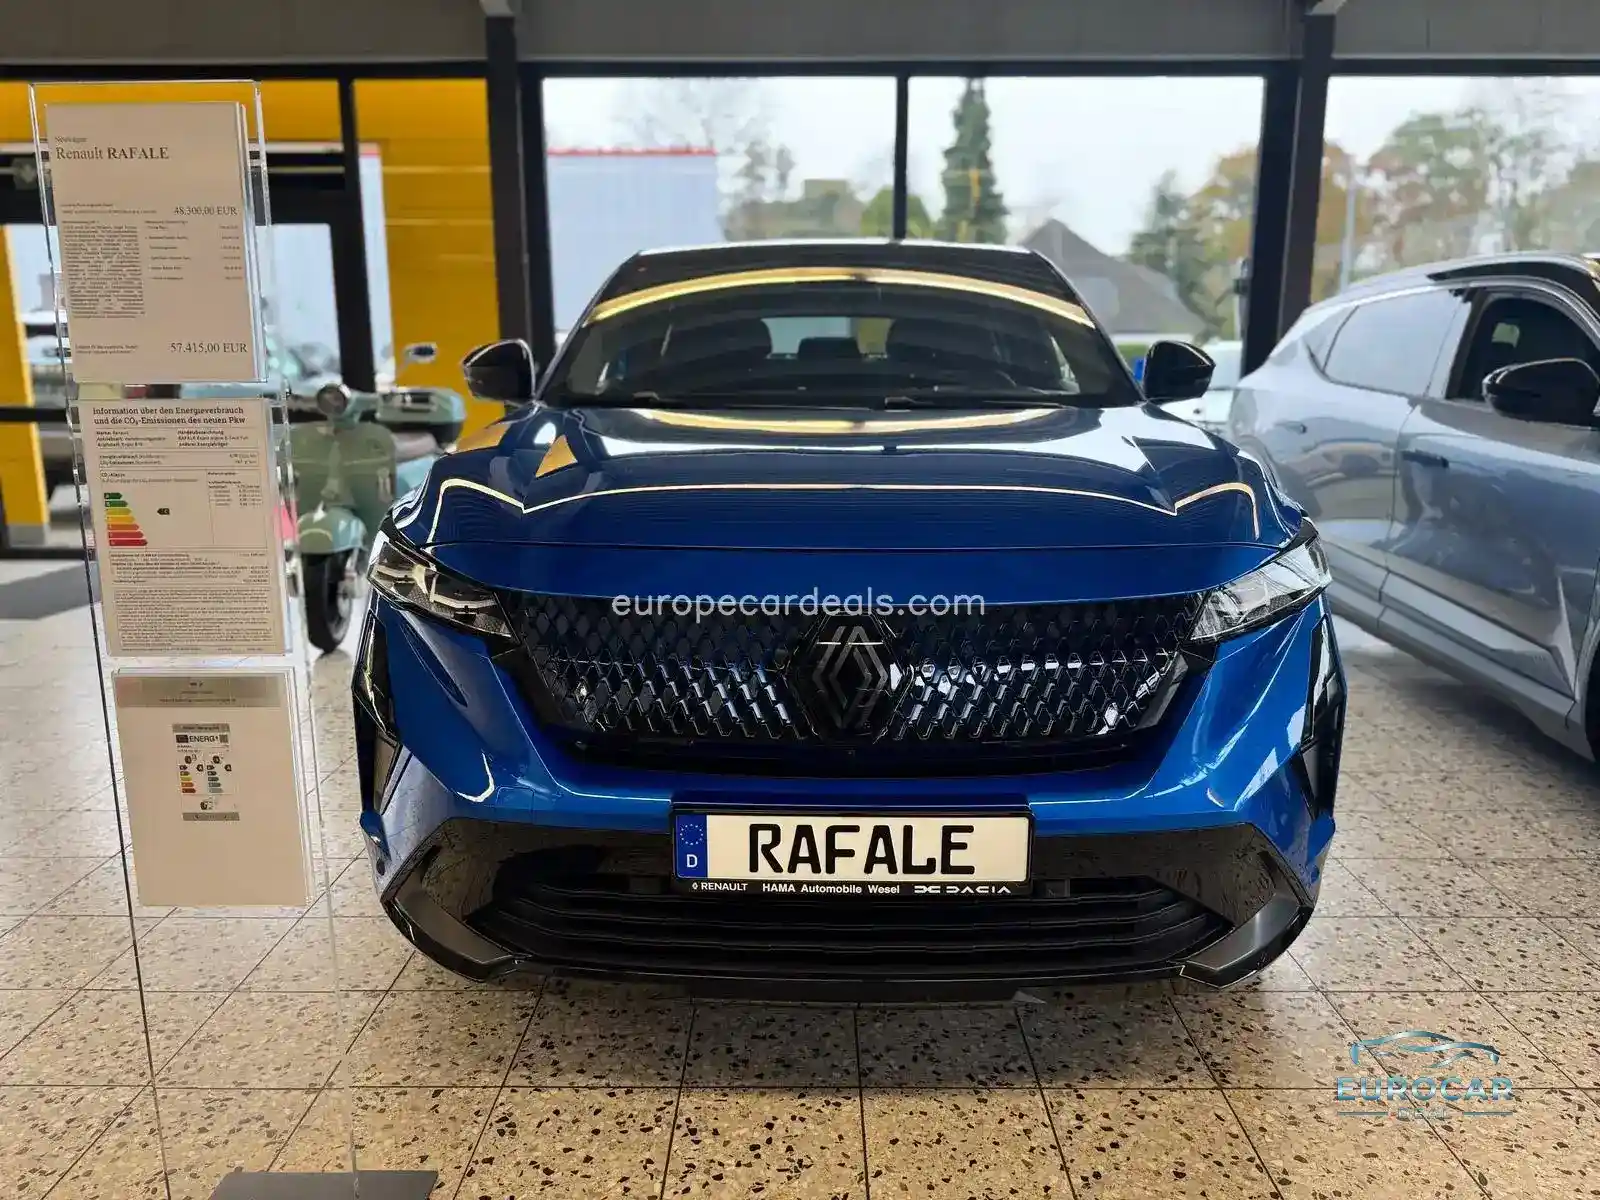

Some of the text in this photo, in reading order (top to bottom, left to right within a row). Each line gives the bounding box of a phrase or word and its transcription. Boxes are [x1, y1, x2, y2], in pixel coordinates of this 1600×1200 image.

[56, 146, 169, 160] Renault RAFALE
[216, 206, 238, 216] EUR
[170, 342, 248, 353] 57.415,00 EUR
[93, 407, 139, 415] Information
[159, 407, 174, 415] den
[175, 406, 244, 416] Energieverbrauch
[94, 417, 109, 425] und
[188, 416, 202, 424] des
[203, 416, 227, 424] neuen
[228, 416, 246, 424] Pkw
[748, 823, 976, 875] RAFALE
[686, 853, 698, 868] D
[700, 881, 748, 891] RENAULT
[762, 883, 900, 894] HAMA Automobile Wesel
[946, 885, 1012, 894] DACIA
